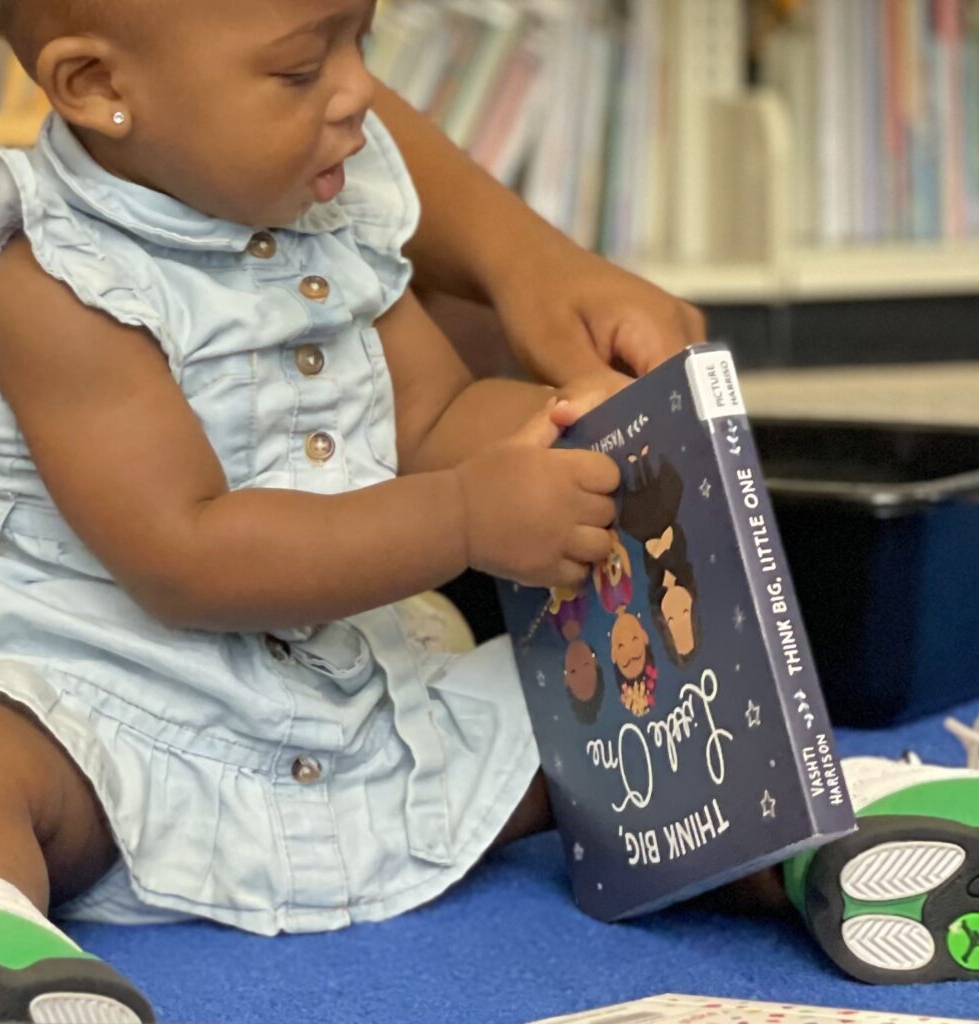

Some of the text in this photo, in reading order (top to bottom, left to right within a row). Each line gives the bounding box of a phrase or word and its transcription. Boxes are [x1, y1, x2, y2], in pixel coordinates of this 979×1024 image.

[706, 365, 724, 408] PICTURE
[737, 468, 759, 509] ONE
[749, 514, 777, 572] LITTLE
[777, 619, 803, 676] THINK
[586, 668, 733, 812] Little One
[802, 746, 825, 797] VASHTI
[816, 734, 843, 805] HARRISON
[619, 798, 730, 865] THINK BIG,
